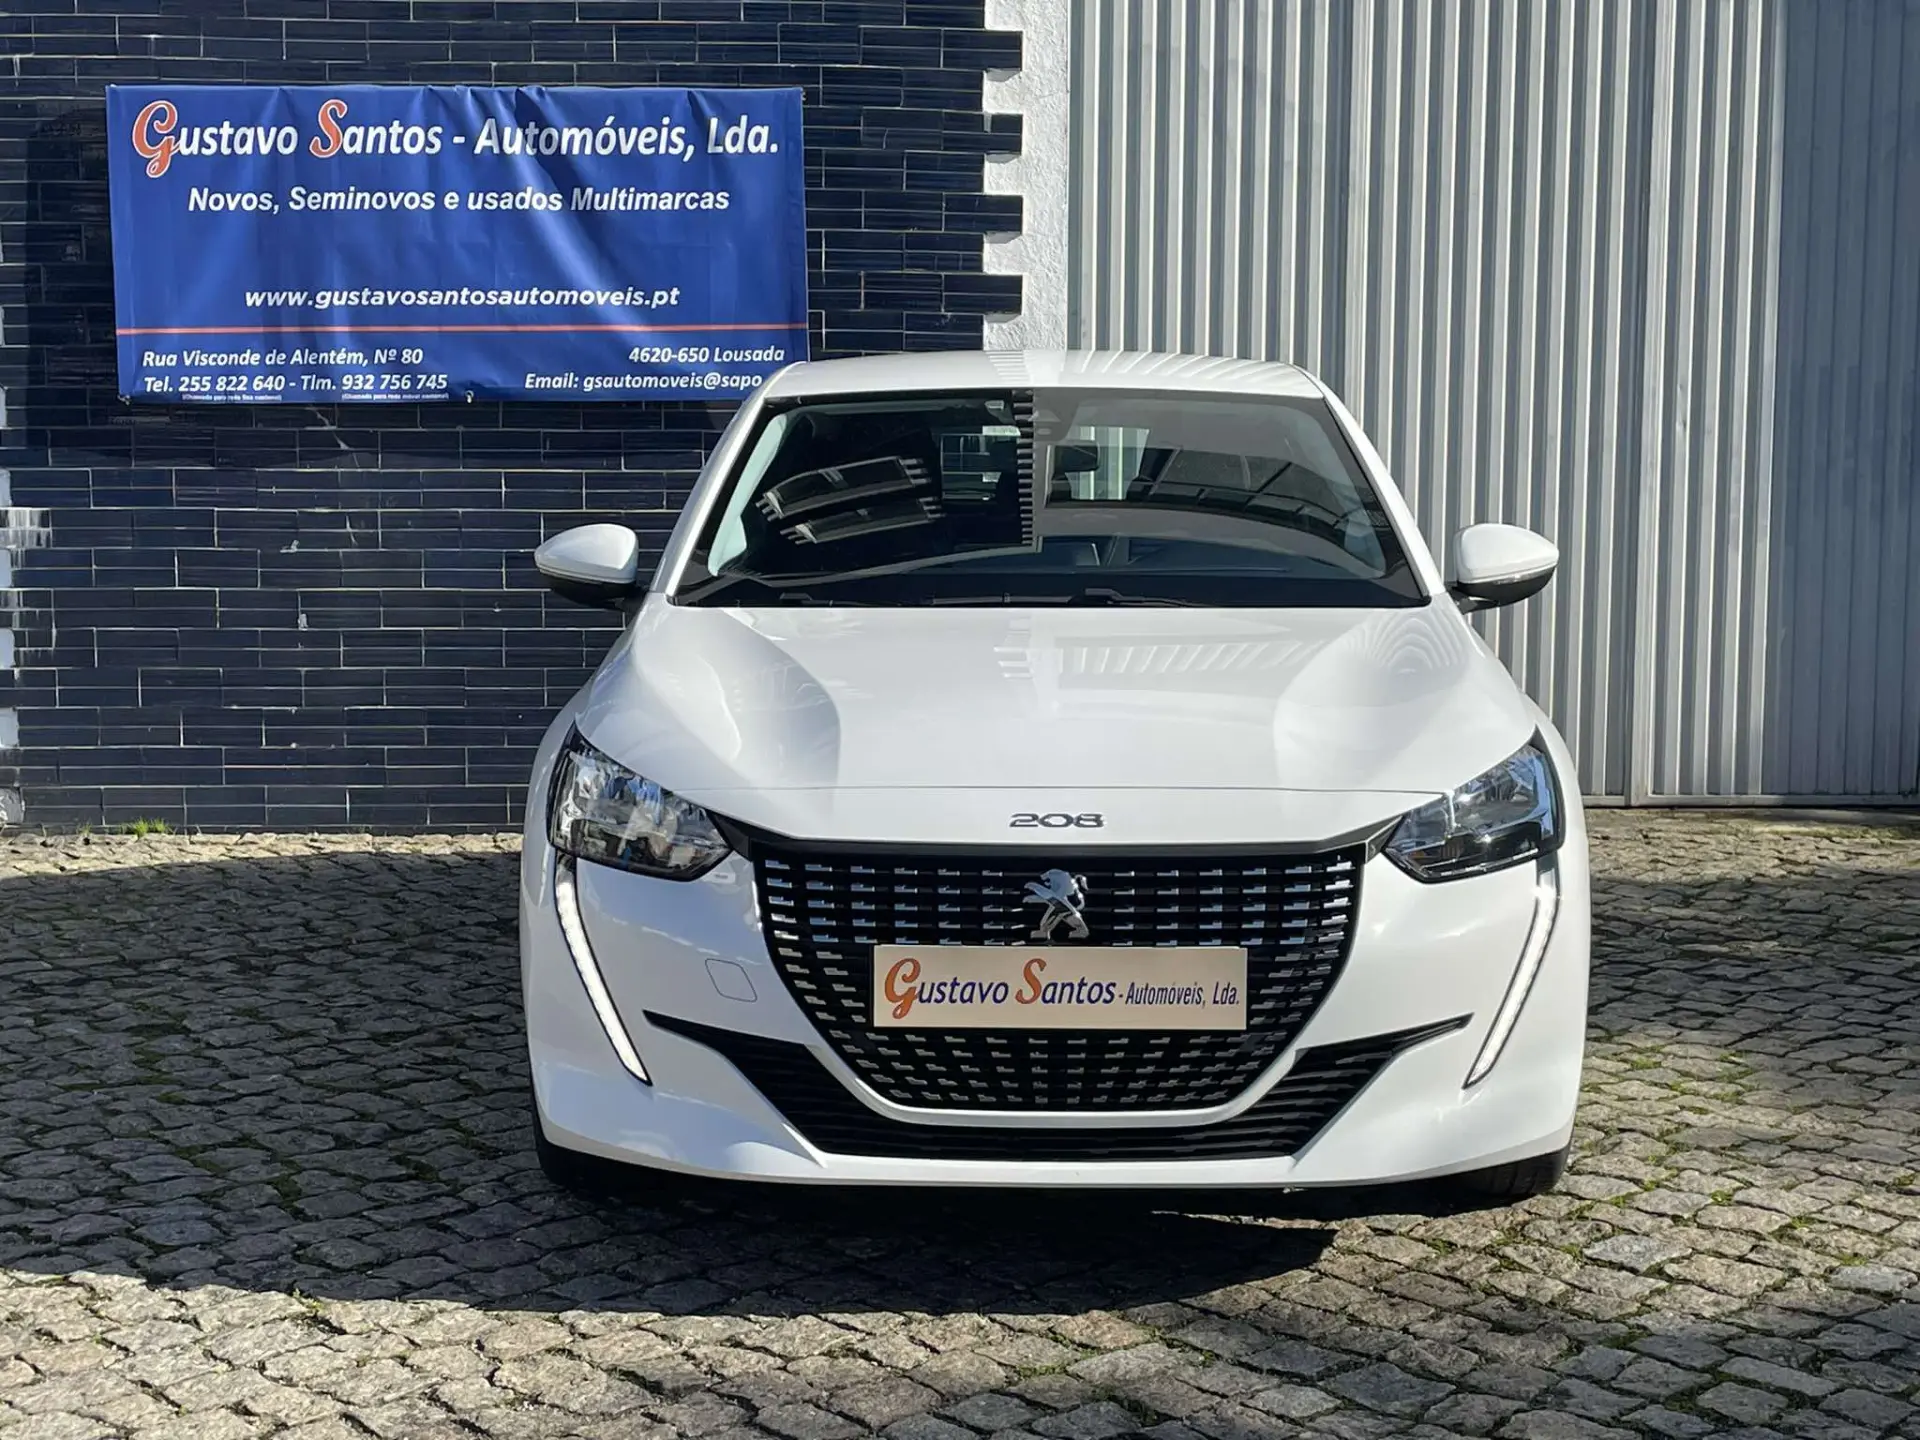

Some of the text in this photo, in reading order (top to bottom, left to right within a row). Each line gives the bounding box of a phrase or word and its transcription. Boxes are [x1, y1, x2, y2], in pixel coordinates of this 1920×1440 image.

[132, 99, 779, 178] Gustavo Santos - Automóveis, Lda.
[188, 186, 730, 214] Novos, Seminovos e usados Multimarcas
[244, 286, 681, 309] www.gustavosantosautomoveis.pt
[142, 351, 177, 367] Rua
[182, 350, 260, 367] Visconde
[265, 350, 286, 365] de
[289, 348, 368, 367] Alentém,
[400, 348, 423, 365] 80
[628, 346, 785, 363] 4620-650 Lousada
[144, 376, 173, 392] Tel.
[178, 376, 211, 392] 255
[215, 375, 247, 391] 822
[252, 375, 285, 391] 640
[300, 375, 336, 391] Tlm.
[341, 374, 375, 390] 932
[379, 374, 411, 390] 756
[416, 374, 448, 390] 745
[524, 372, 763, 394] Email: gsautomoveis@sapo
[1008, 812, 1104, 829] 208
[884, 957, 1009, 1019] Gustavo
[1015, 957, 1116, 1005] Santos
[1125, 981, 1206, 1009] Automóveis,
[1212, 982, 1240, 1006] Lda.
